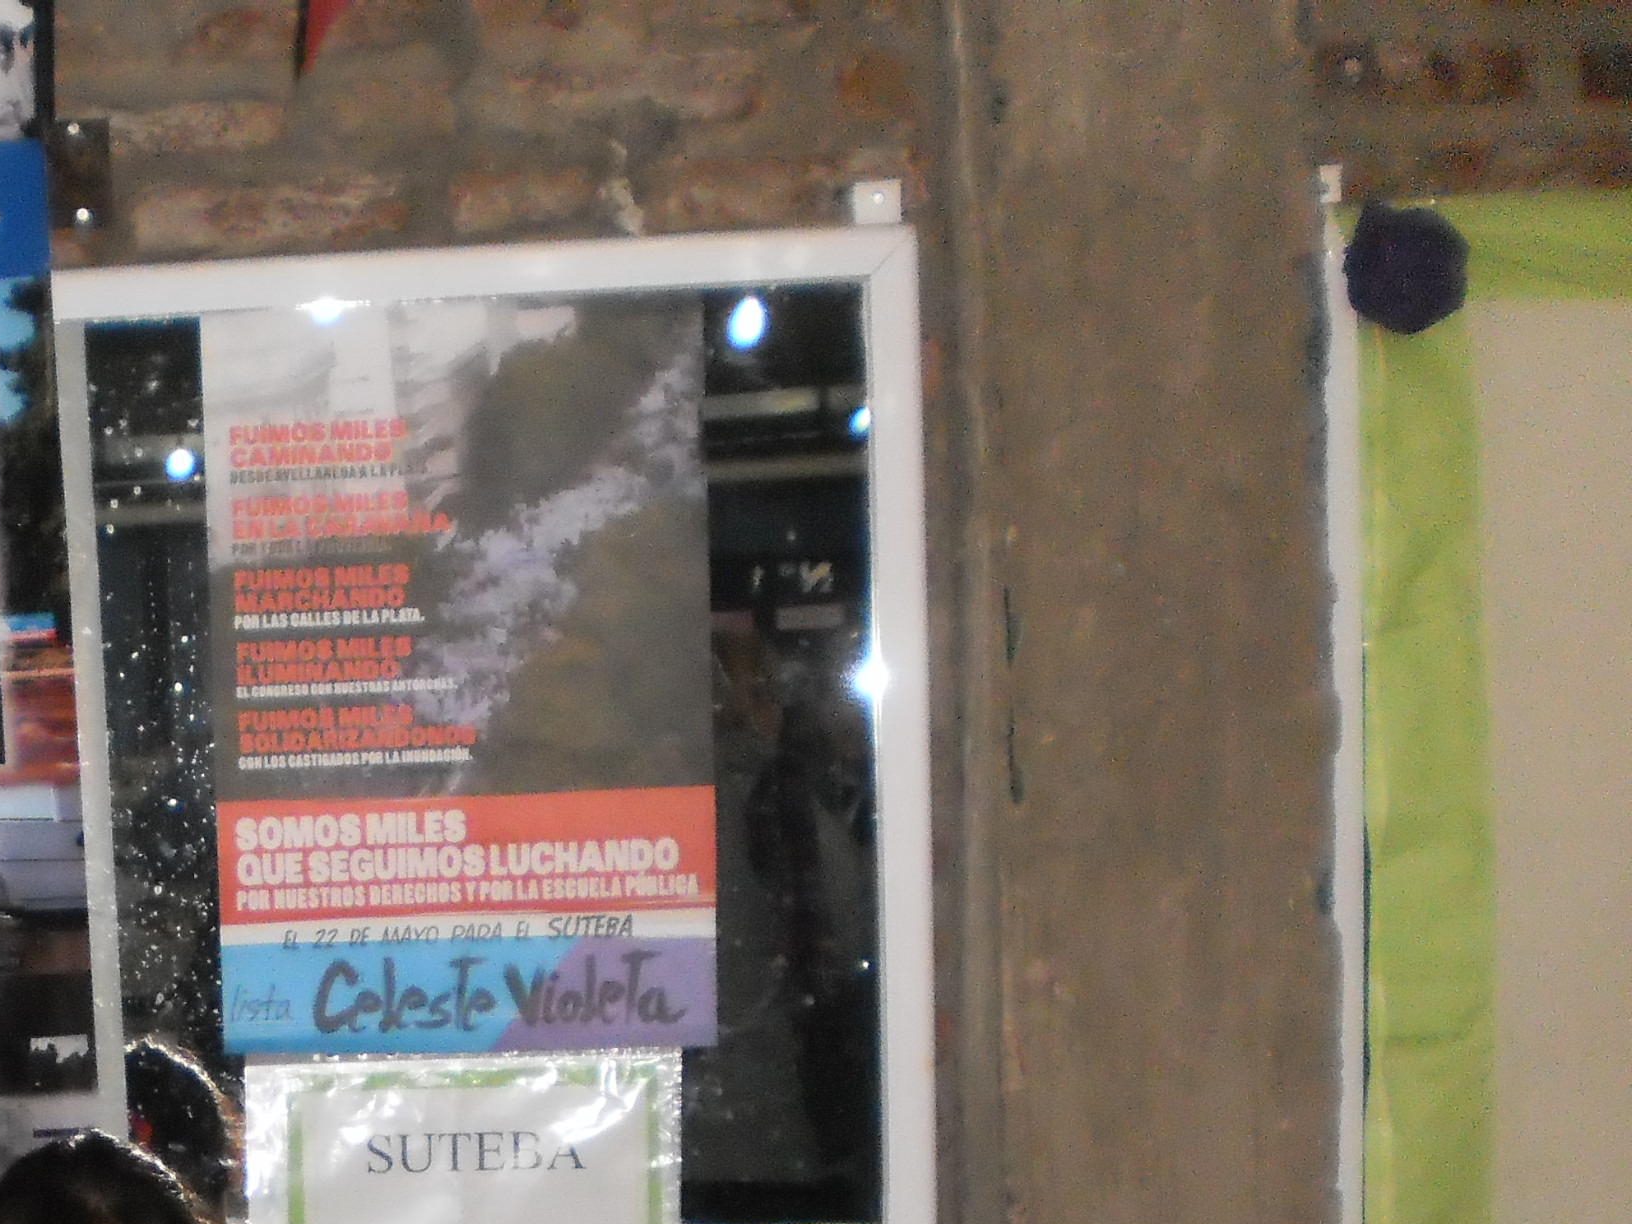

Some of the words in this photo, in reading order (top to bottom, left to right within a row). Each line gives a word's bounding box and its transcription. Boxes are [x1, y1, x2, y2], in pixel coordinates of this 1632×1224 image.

[229, 422, 326, 446] FUIMOS
[330, 418, 407, 441] MILES
[234, 566, 330, 592] FUIMOS
[334, 562, 411, 587] MILES
[234, 613, 260, 630] POR
[262, 612, 288, 629] LAS
[290, 610, 341, 628] CALLES
[342, 609, 360, 626] DE
[362, 608, 380, 625] LA
[236, 637, 334, 664] FUIMOS
[336, 633, 413, 660] MILES
[310, 681, 333, 696] CON
[238, 705, 335, 732] FUIMOS
[338, 703, 413, 728] MILES
[238, 755, 262, 770] CON
[264, 754, 286, 769] LOS
[360, 749, 384, 765] POR
[385, 748, 400, 764] LA
[235, 813, 361, 851] SOMOS
[366, 808, 467, 847] MILES
[236, 849, 304, 887] QUE
[309, 842, 487, 884] SEGUIMOS
[489, 836, 680, 877] LUCHANDO
[236, 889, 270, 912] POR
[273, 885, 366, 910] NUESTROS
[368, 881, 462, 907] DERECHOS
[466, 880, 477, 902] Y
[478, 880, 513, 903] POR
[517, 878, 538, 901] LA
[542, 874, 621, 900] ESCUELA
[282, 928, 300, 950] EL
[313, 928, 337, 949] 22
[348, 926, 370, 947] DE
[380, 925, 440, 946] MAYO
[548, 913, 635, 939] SUTEBA
[312, 956, 496, 1036] Celeste
[503, 948, 688, 1028] Violeta
[366, 1129, 588, 1176] SUTEBA
